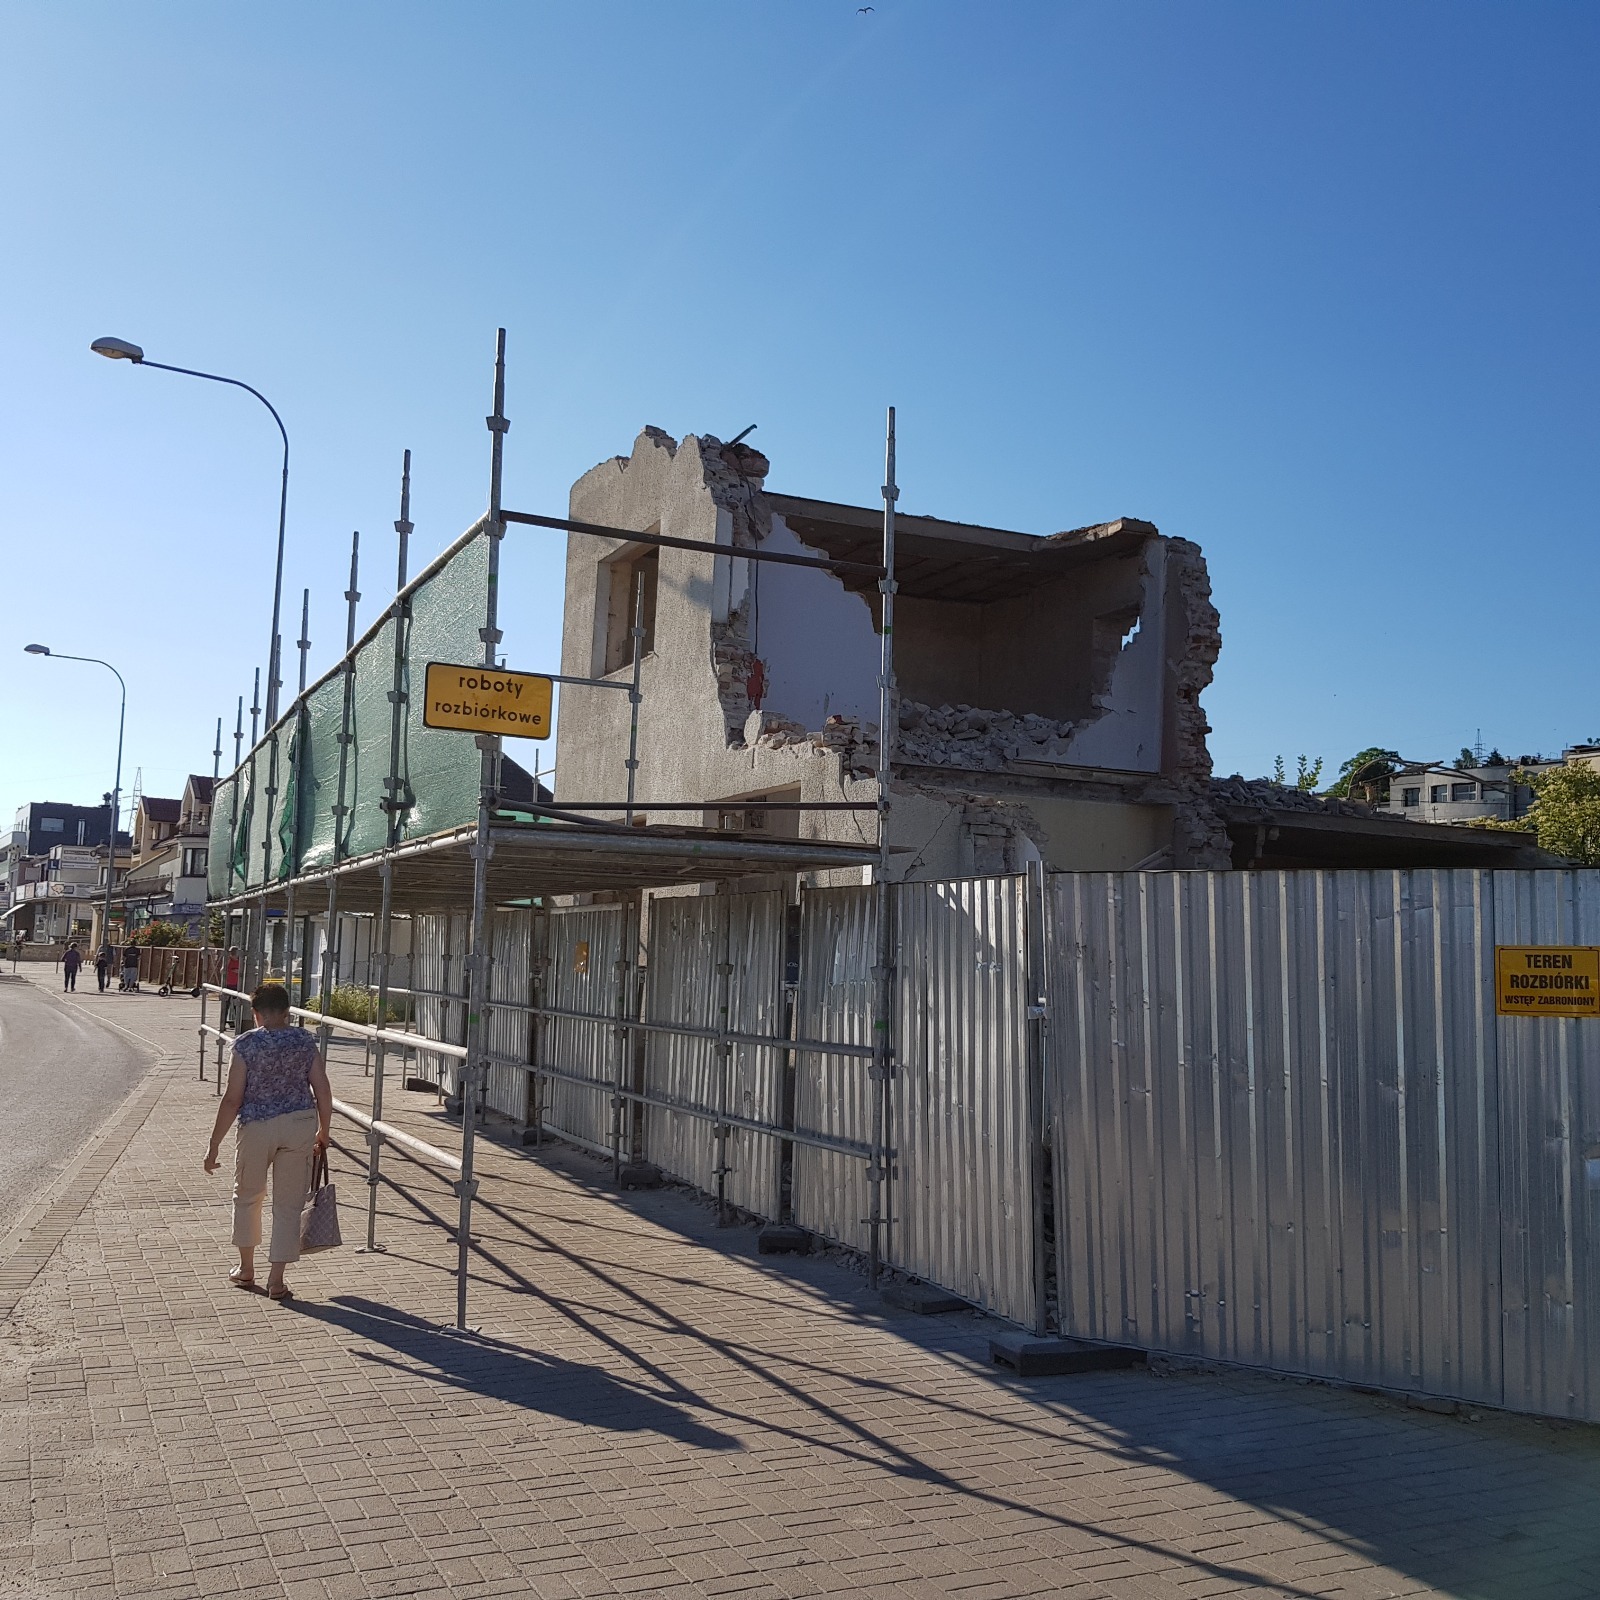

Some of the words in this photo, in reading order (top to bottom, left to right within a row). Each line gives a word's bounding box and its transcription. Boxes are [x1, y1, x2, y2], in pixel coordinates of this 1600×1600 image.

[459, 674, 523, 699] roboty
[435, 701, 541, 725] rozbiórkowe
[1525, 954, 1572, 969] TEREN
[1510, 972, 1590, 990] ROZBIÓRKI
[1505, 995, 1535, 1006] WSTĘP
[1537, 996, 1595, 1006] ZABRONIONY
